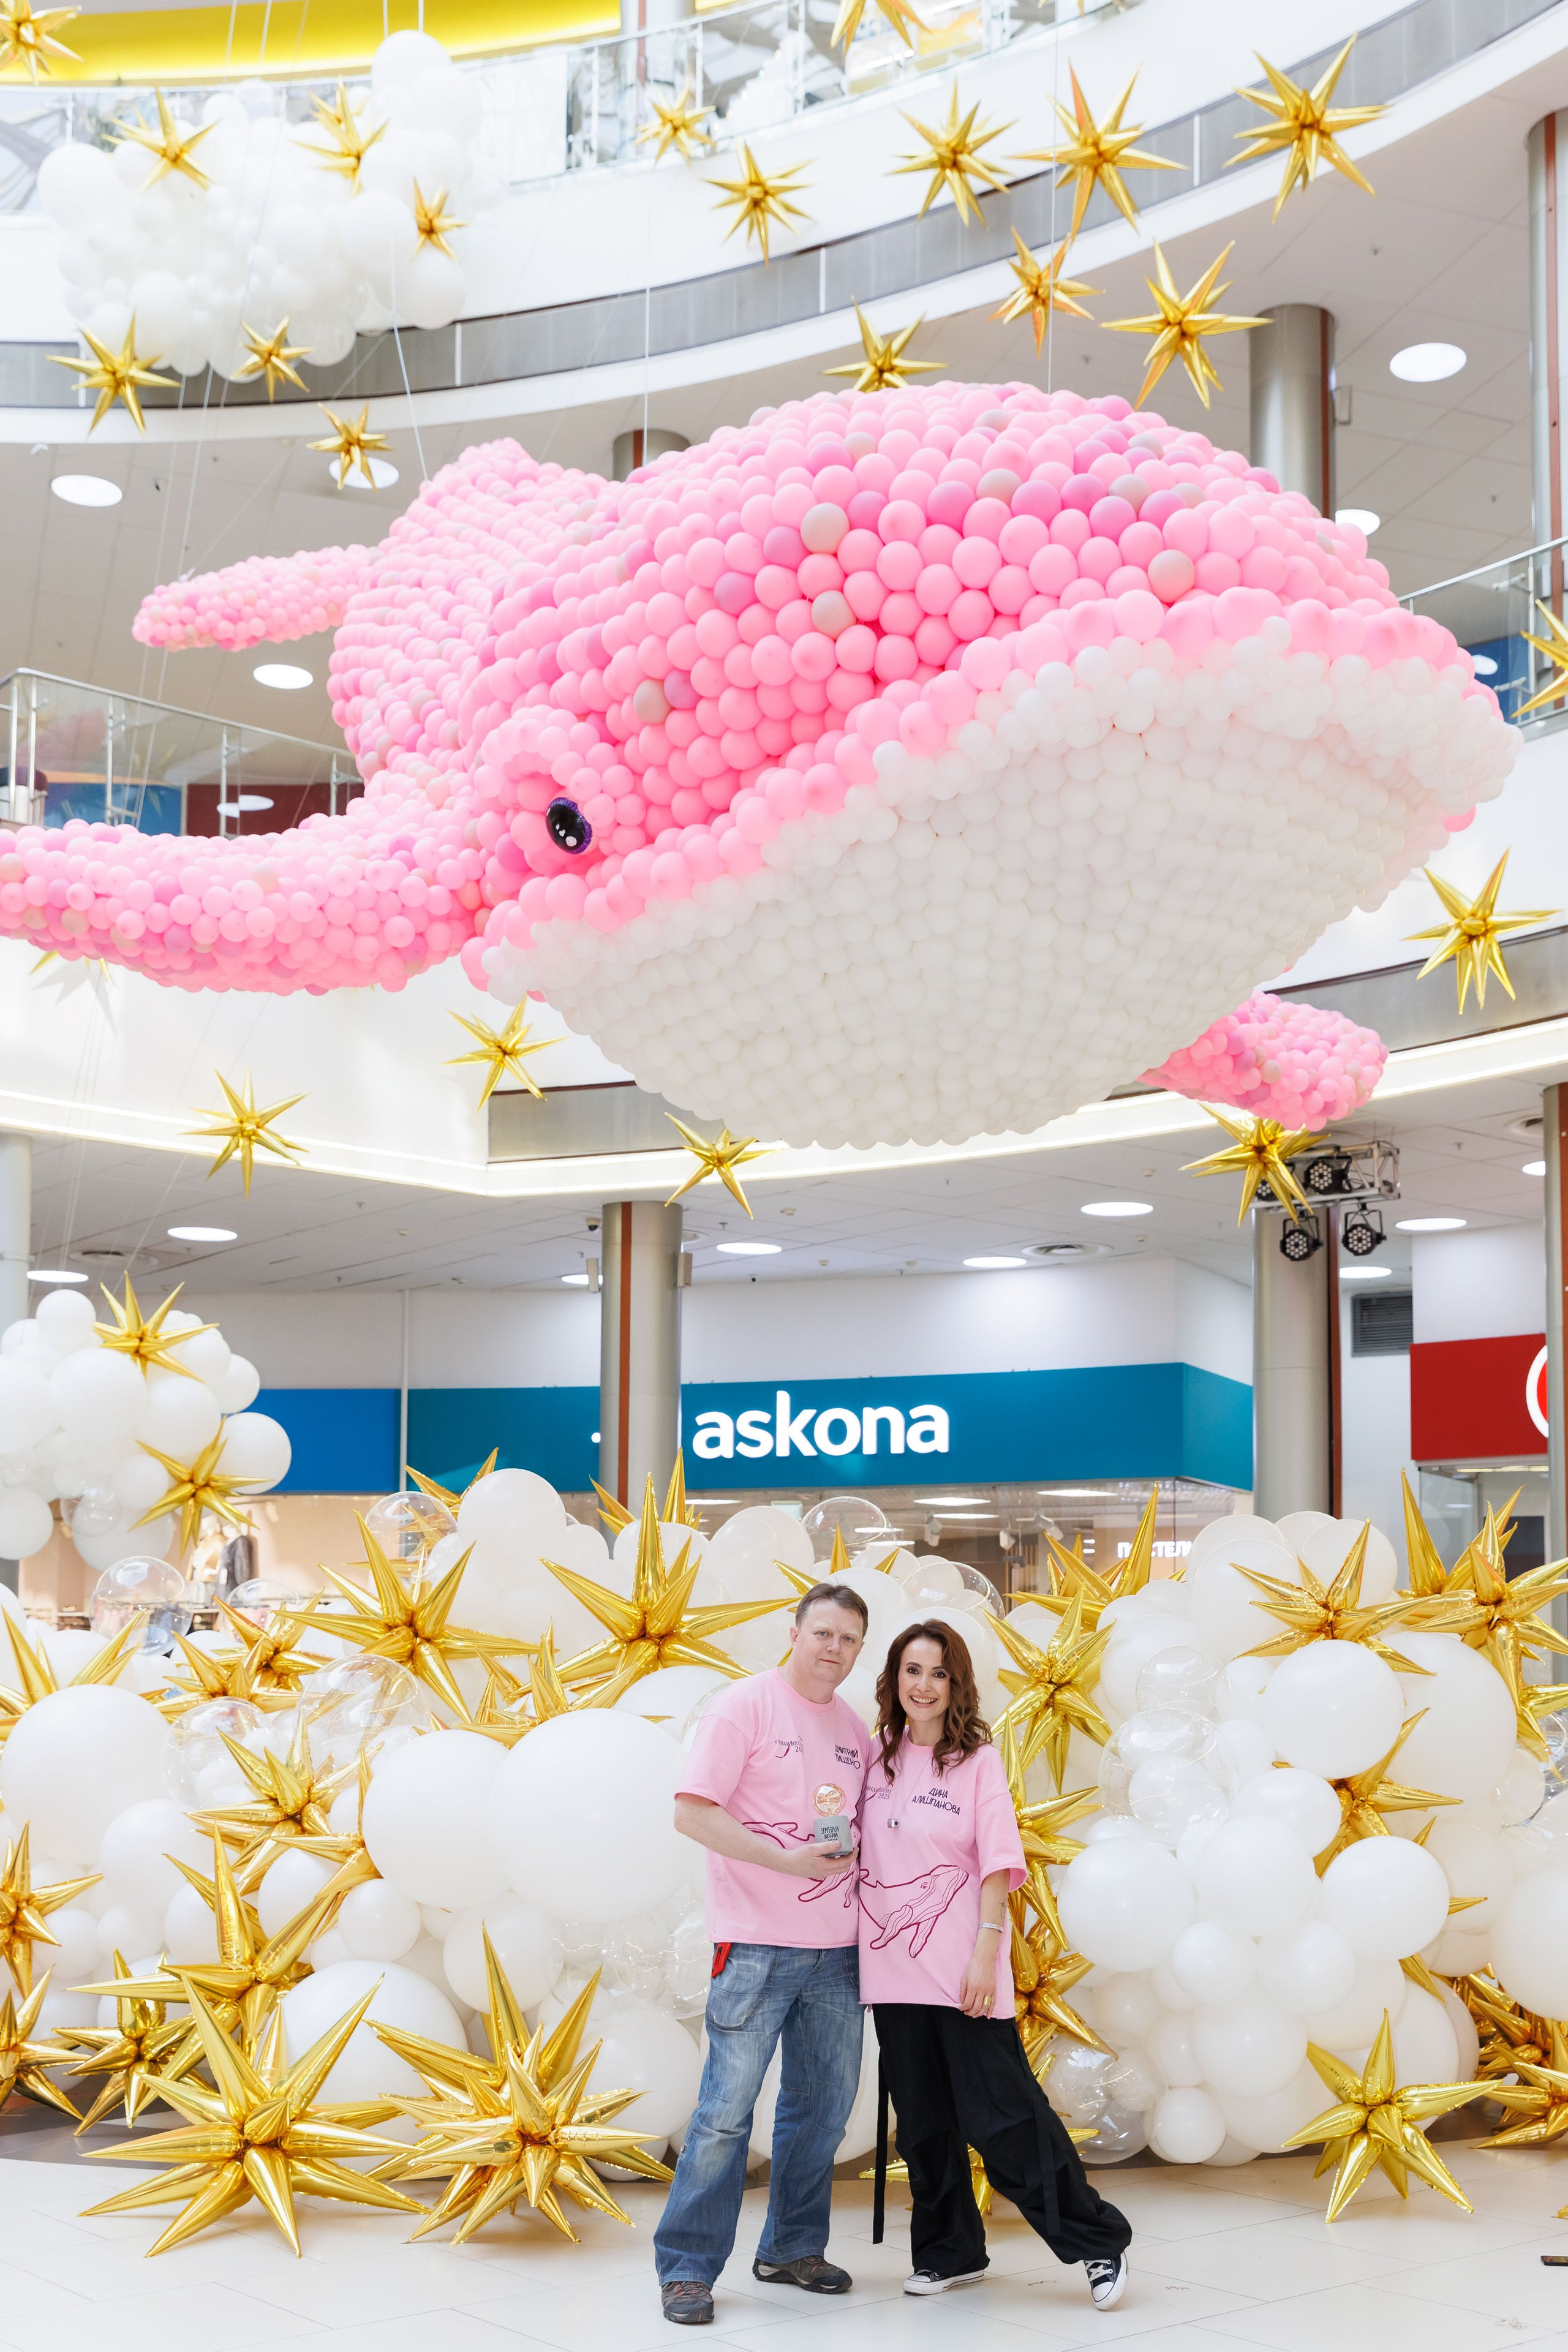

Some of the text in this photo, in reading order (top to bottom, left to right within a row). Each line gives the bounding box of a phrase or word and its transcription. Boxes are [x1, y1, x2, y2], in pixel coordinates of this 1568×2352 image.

[693, 1390, 949, 1459] askona
[929, 1788, 948, 1798] ДИНА
[911, 1795, 960, 1815] АЛИШПАНОВА
